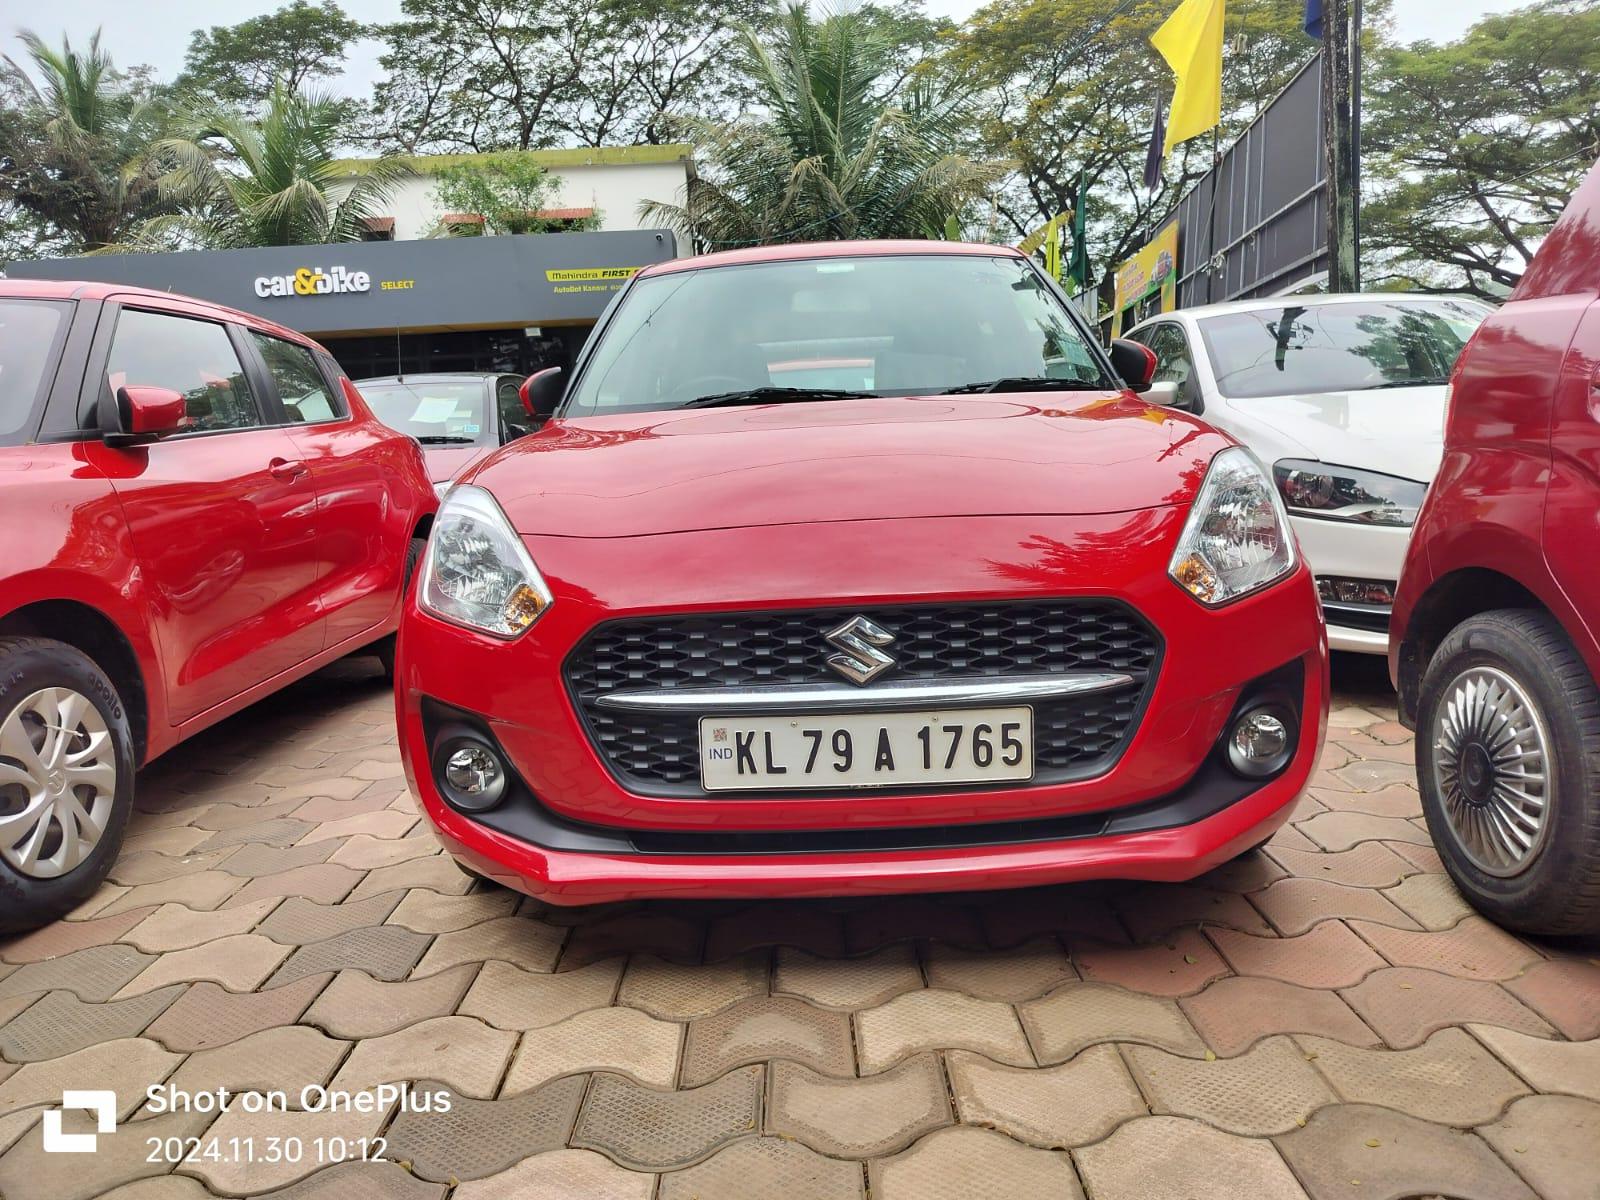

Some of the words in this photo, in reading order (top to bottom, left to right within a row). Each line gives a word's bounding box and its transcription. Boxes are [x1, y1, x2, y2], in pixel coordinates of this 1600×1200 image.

[254, 265, 371, 298] car&bike
[380, 280, 415, 290] SELECT
[552, 271, 598, 280] Mahindra
[602, 269, 631, 278] FIRST
[88, 671, 121, 719] apollo
[709, 747, 733, 761] IND
[735, 731, 787, 775] KL
[802, 729, 853, 774] 79
[874, 727, 895, 771] A
[917, 722, 1023, 770] 1765
